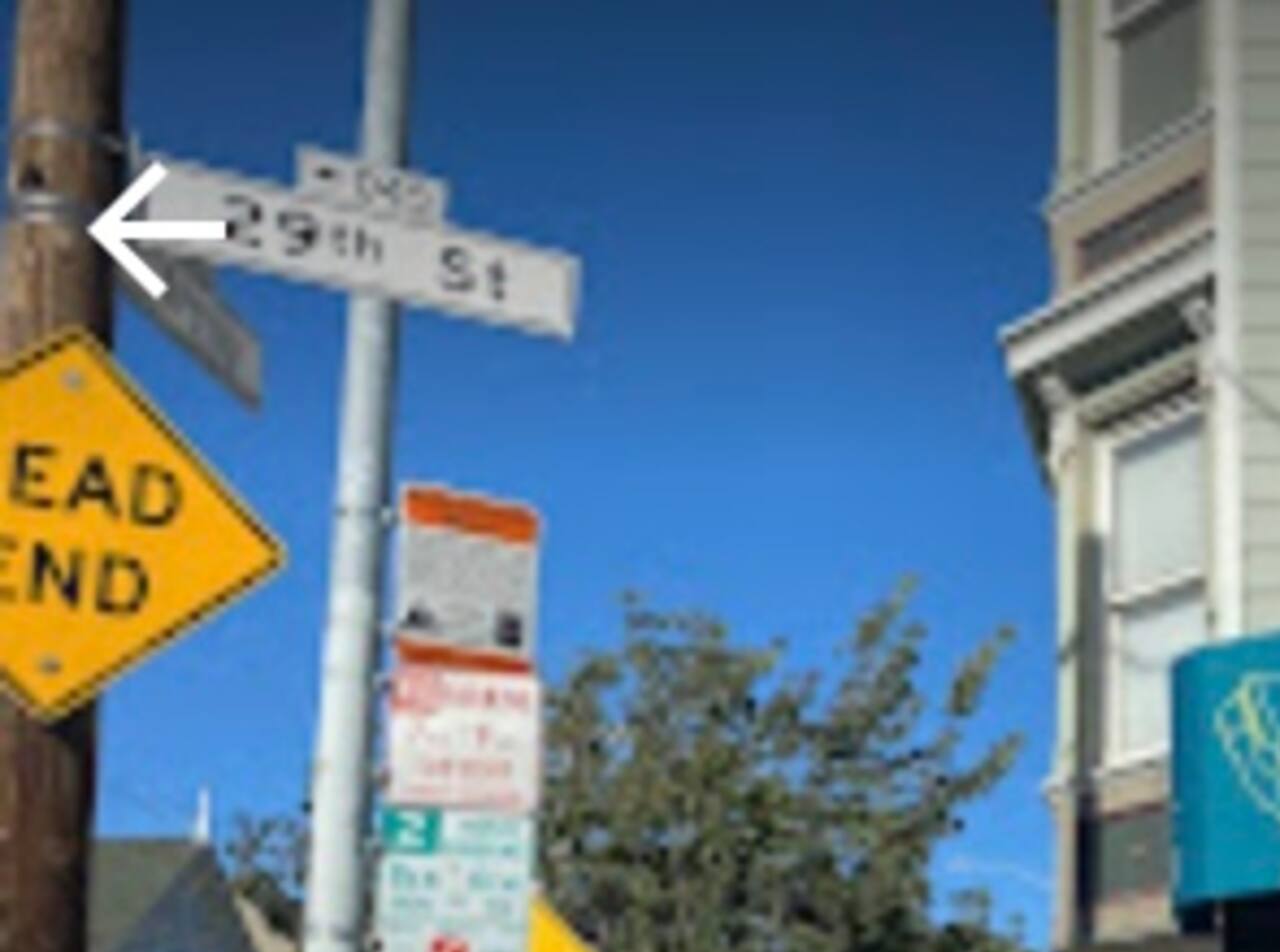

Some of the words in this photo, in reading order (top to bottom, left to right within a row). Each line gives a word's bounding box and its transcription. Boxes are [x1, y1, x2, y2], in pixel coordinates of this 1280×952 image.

[222, 193, 383, 264] 29th
[438, 245, 506, 302] St
[8, 442, 183, 527] EAD
